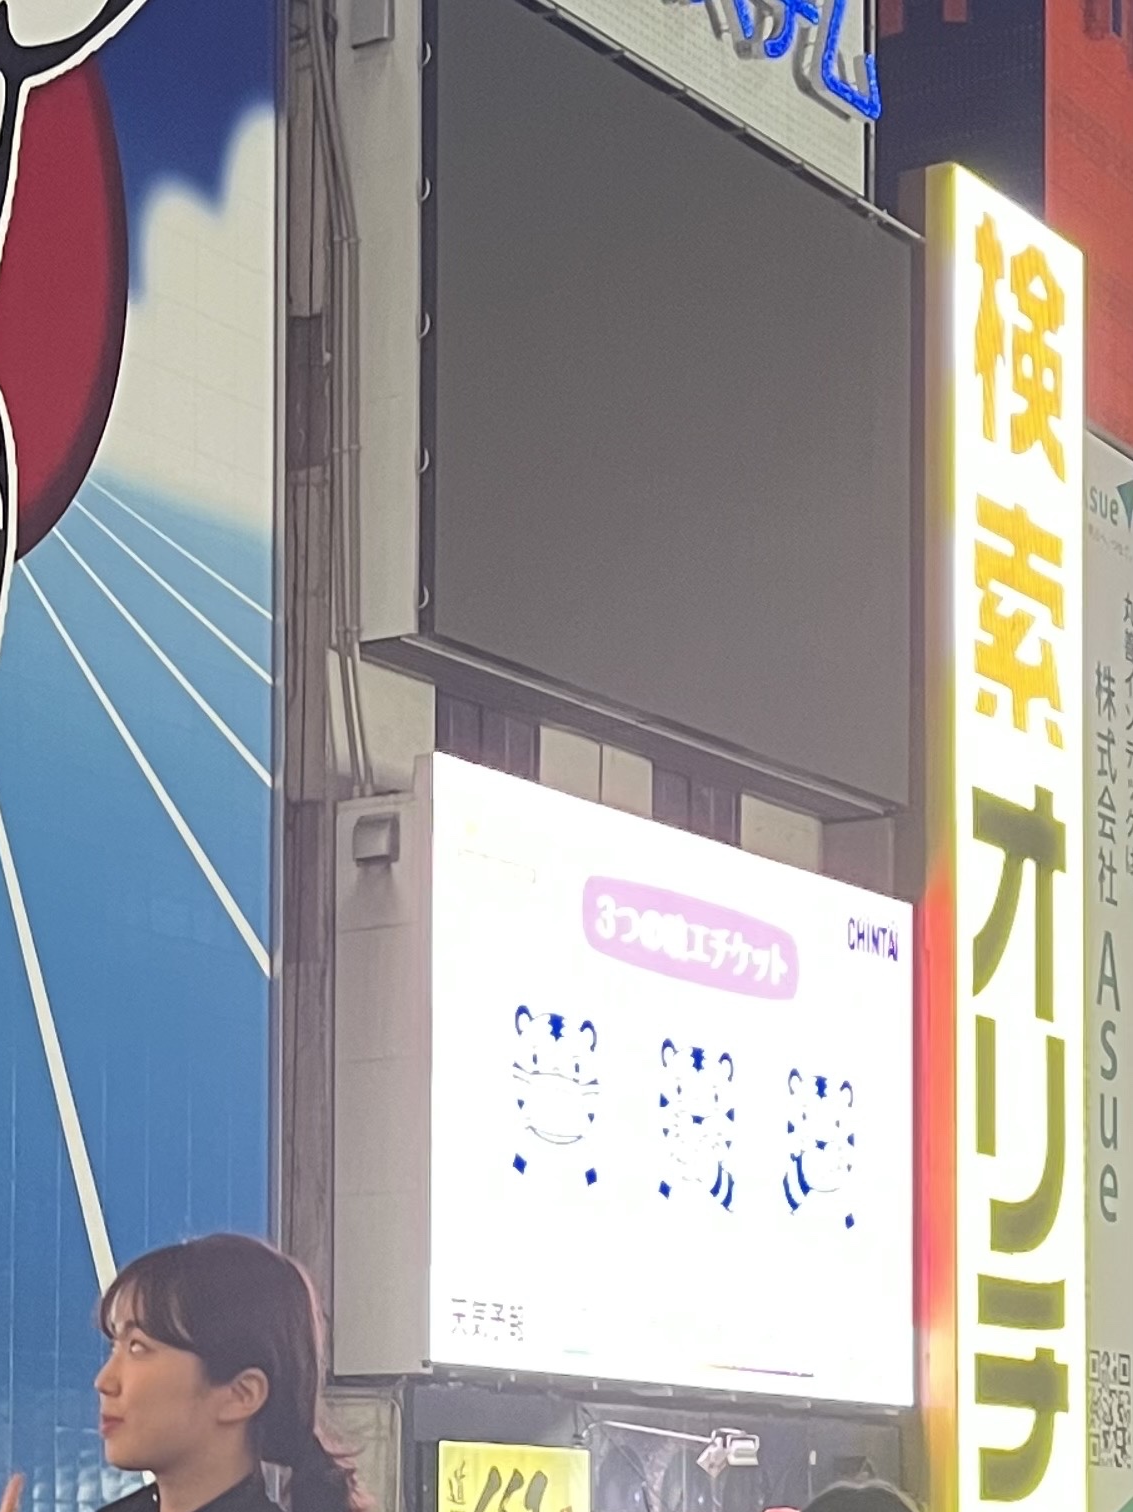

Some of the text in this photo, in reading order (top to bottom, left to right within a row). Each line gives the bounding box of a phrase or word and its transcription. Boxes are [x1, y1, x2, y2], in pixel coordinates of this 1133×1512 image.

[1085, 485, 1119, 527] sue
[1096, 661, 1117, 907] 株式会社
[1096, 930, 1121, 1223] Asue
